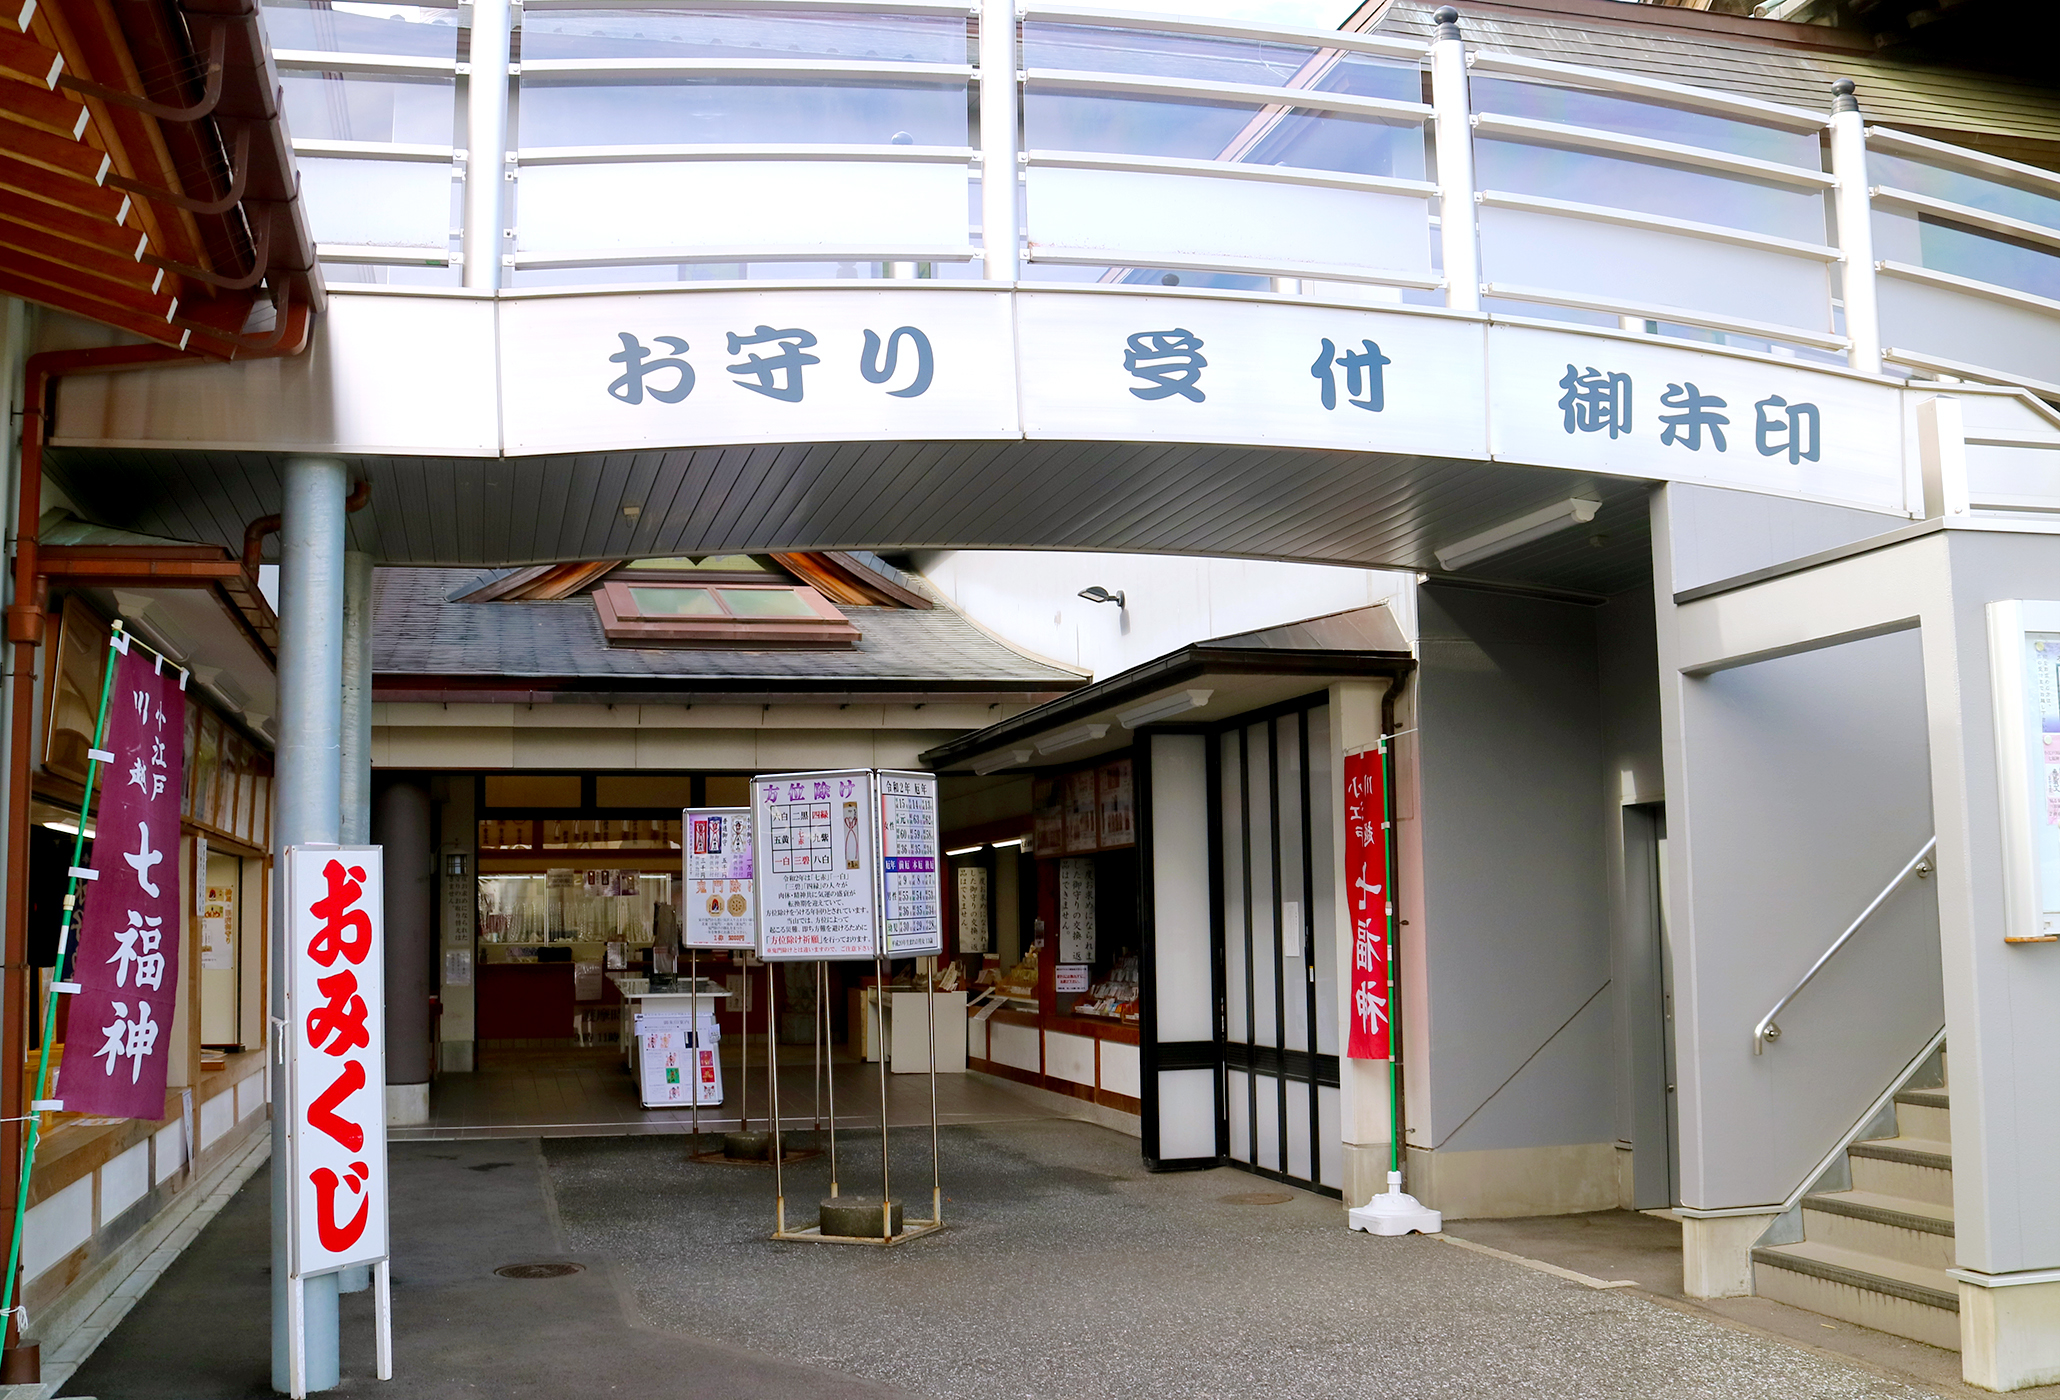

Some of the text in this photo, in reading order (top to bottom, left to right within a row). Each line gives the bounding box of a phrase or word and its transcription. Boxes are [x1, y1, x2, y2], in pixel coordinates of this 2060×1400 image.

[607, 325, 1821, 465] お守り 受付 御朱印
[127, 690, 148, 795] 川越
[150, 699, 168, 802] 小江戸
[763, 780, 856, 804] 方位除け
[792, 811, 809, 820] 二黒
[812, 810, 829, 819] 四緑
[774, 835, 790, 844] 五黄
[775, 857, 790, 866] 一白
[794, 855, 810, 865] 三碧
[813, 833, 829, 843] 九紫
[814, 855, 830, 864] 八白
[1062, 860, 1070, 935] 品はできません。
[1072, 861, 1082, 961] した御守りの交換・返
[1085, 862, 1094, 960] 一度お求めになられま
[93, 821, 166, 1085] 七福神
[306, 858, 373, 1253] おみくじ
